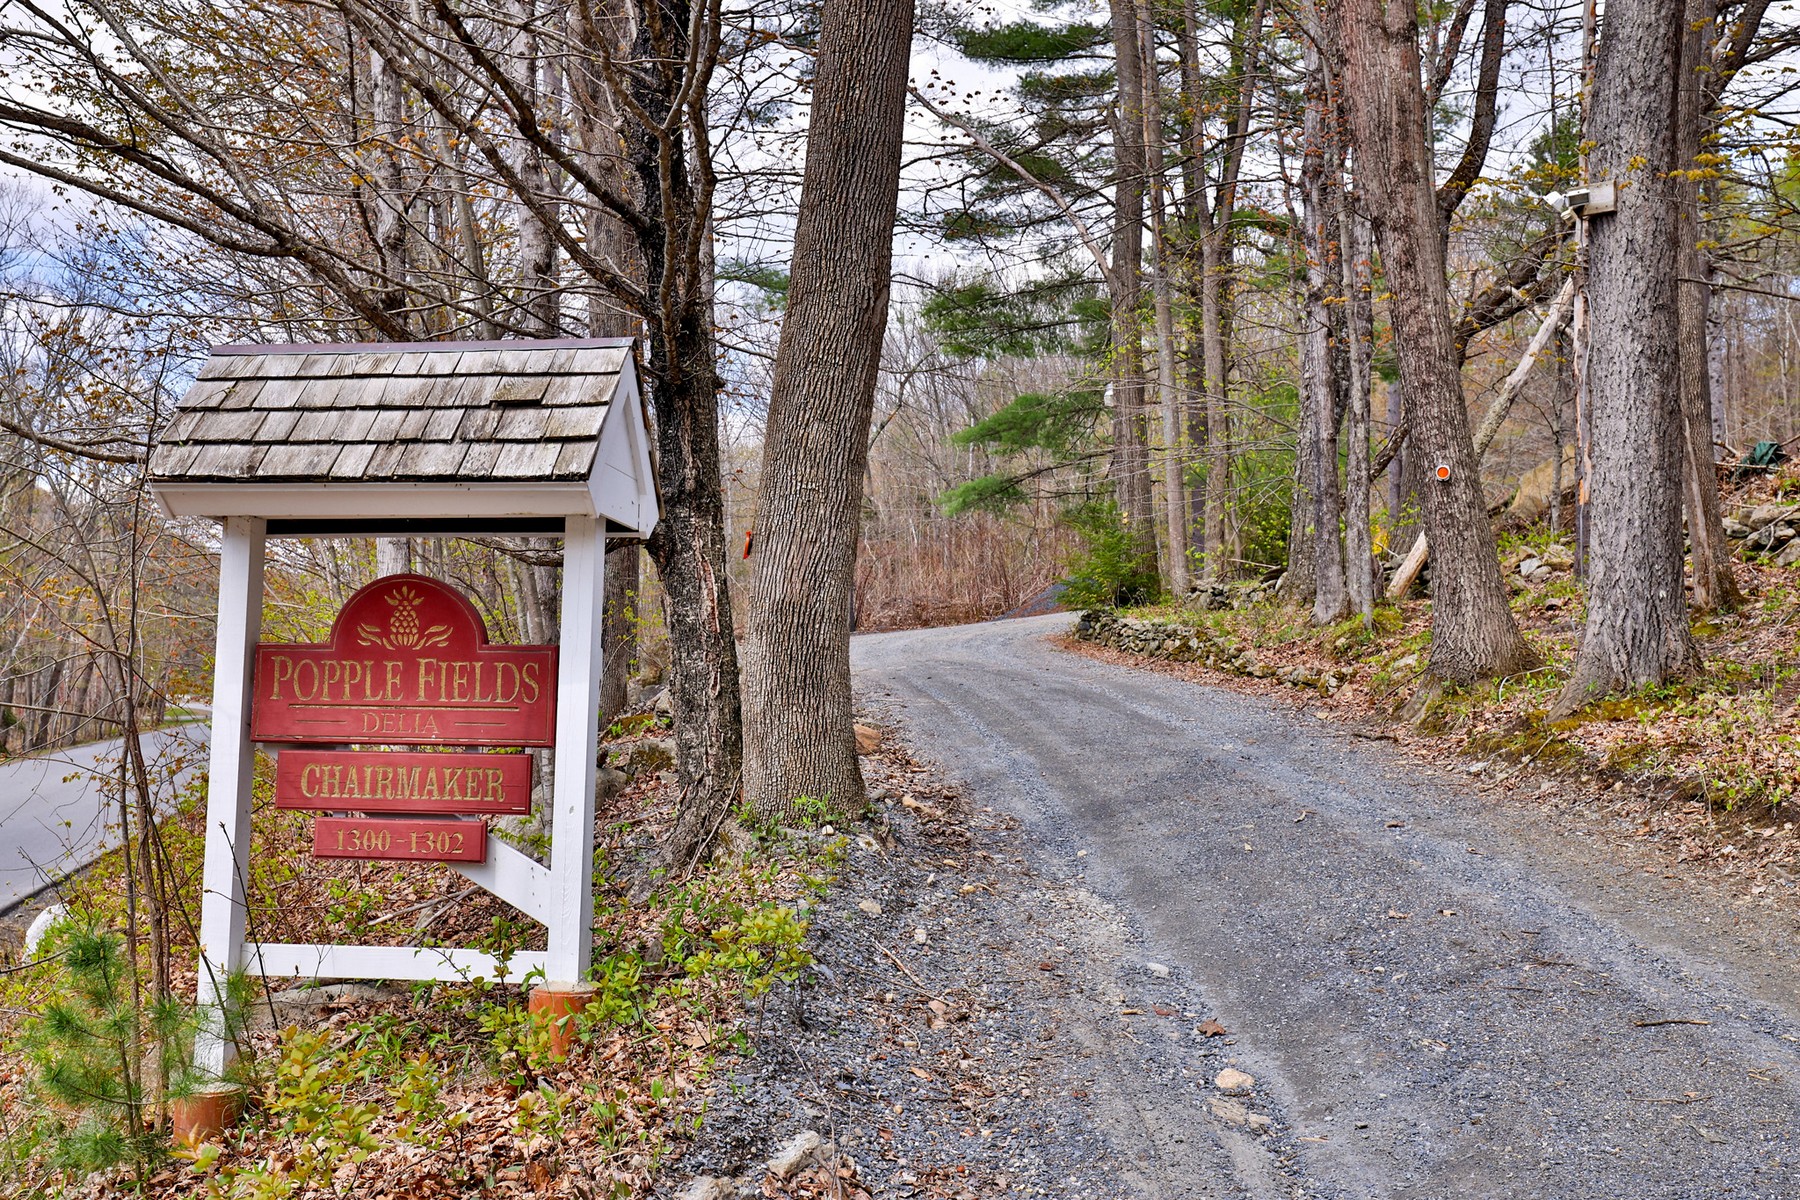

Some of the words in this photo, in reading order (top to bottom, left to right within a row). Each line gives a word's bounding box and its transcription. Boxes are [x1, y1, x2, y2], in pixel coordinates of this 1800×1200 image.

[270, 655, 404, 701] POPPLE
[416, 658, 540, 704] FIELDS
[361, 711, 441, 734] DELIA
[301, 762, 506, 802] CHAIRMAKER
